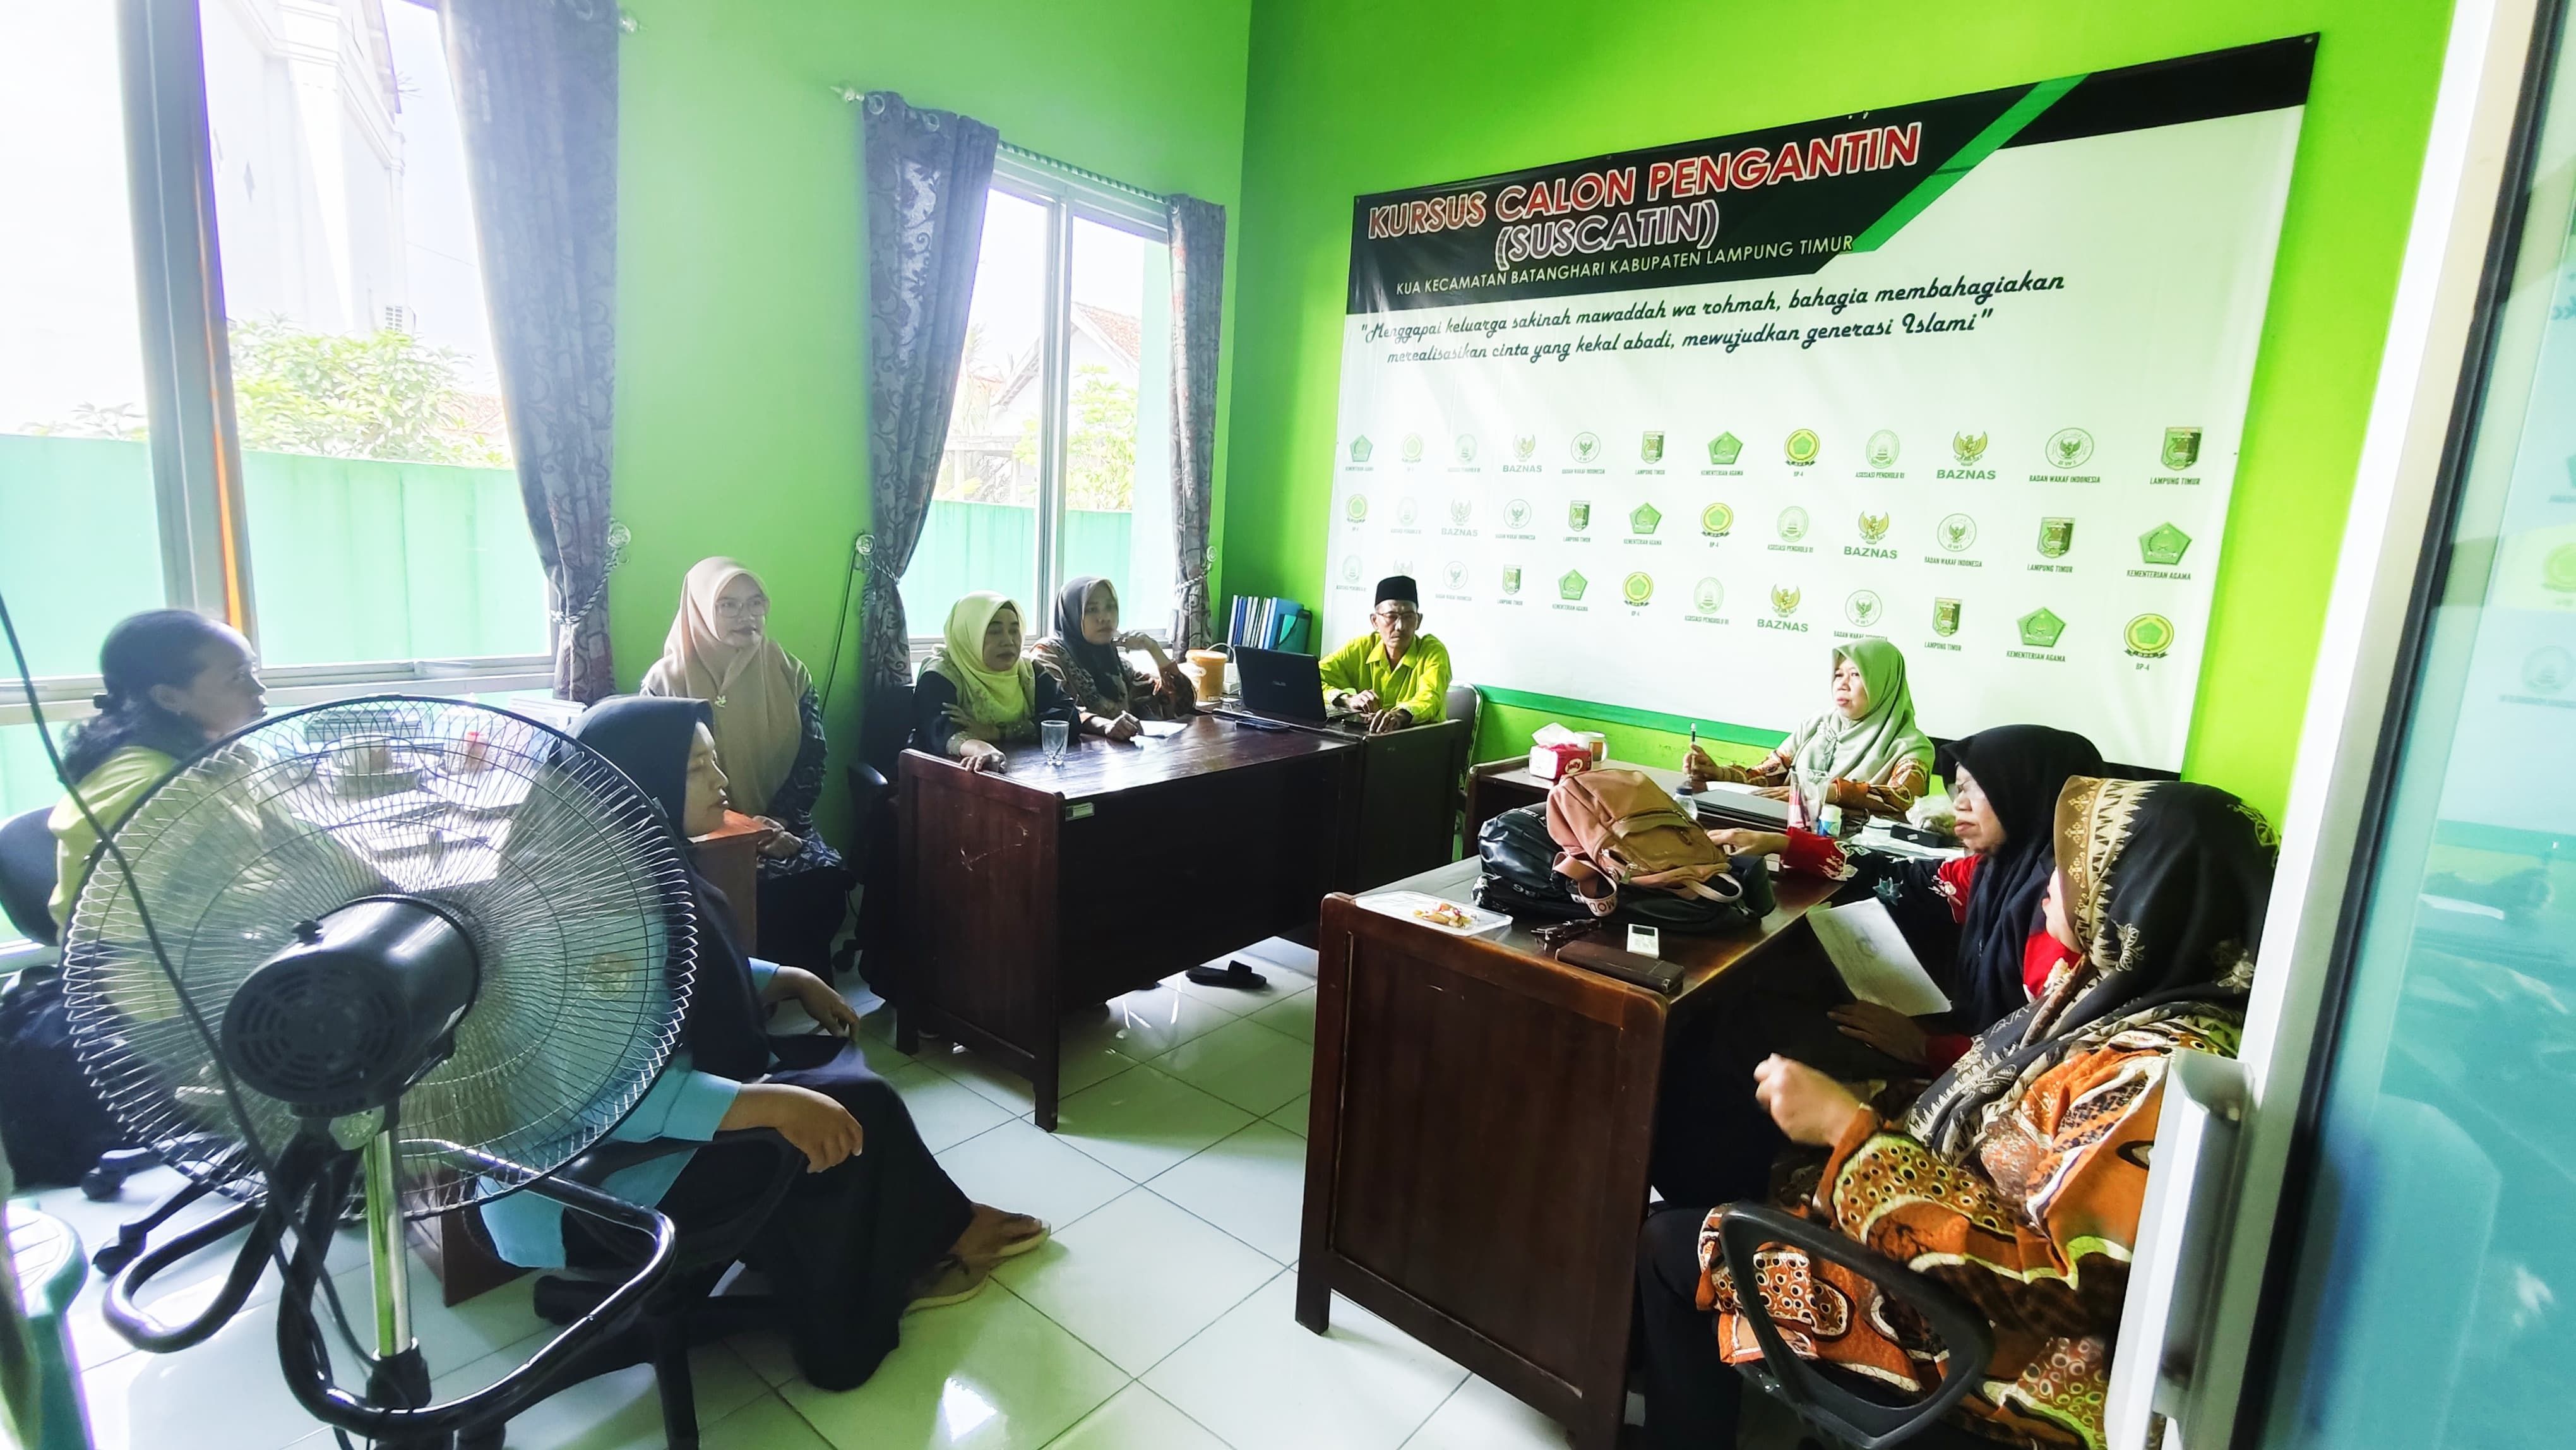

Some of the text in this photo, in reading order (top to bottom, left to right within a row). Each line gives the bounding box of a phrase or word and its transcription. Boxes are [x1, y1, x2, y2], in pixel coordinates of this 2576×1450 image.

[1368, 122, 1922, 240] KURSUS CALON PENGANTIN
[1494, 200, 1719, 271] (SUSCATIN)
[1396, 234, 1854, 295] KUA KECAMATAN BATANGHARI KABUPATEN LAMPUNG TIMUR
[1445, 316, 1507, 340] keluarga
[1512, 313, 1570, 328] sakinah
[1576, 301, 1666, 324] mawaddah
[1672, 304, 1696, 317] wa
[1702, 292, 1781, 314] rohmah,
[1789, 287, 1868, 314] bahagia
[1875, 270, 2065, 304] membahagiakan
[1492, 344, 1529, 357] cinta
[1531, 343, 1570, 364] yang
[1575, 333, 1618, 353] kekal
[1623, 330, 1674, 350] abadi,
[1682, 323, 1799, 353] mewujudkan
[1803, 320, 1893, 349] generasi
[1936, 470, 1996, 479] BAZNAS
[1844, 546, 1898, 559] BAZNAS
[2027, 564, 2053, 572] LAMPUNG
[2127, 570, 2191, 580] KEMENTERIAN AGAMA
[1757, 619, 1808, 632] BAZNAS
[1924, 642, 1946, 650] LAMPUNG
[2007, 650, 2066, 662] KEMENTERIAN AGAMA
